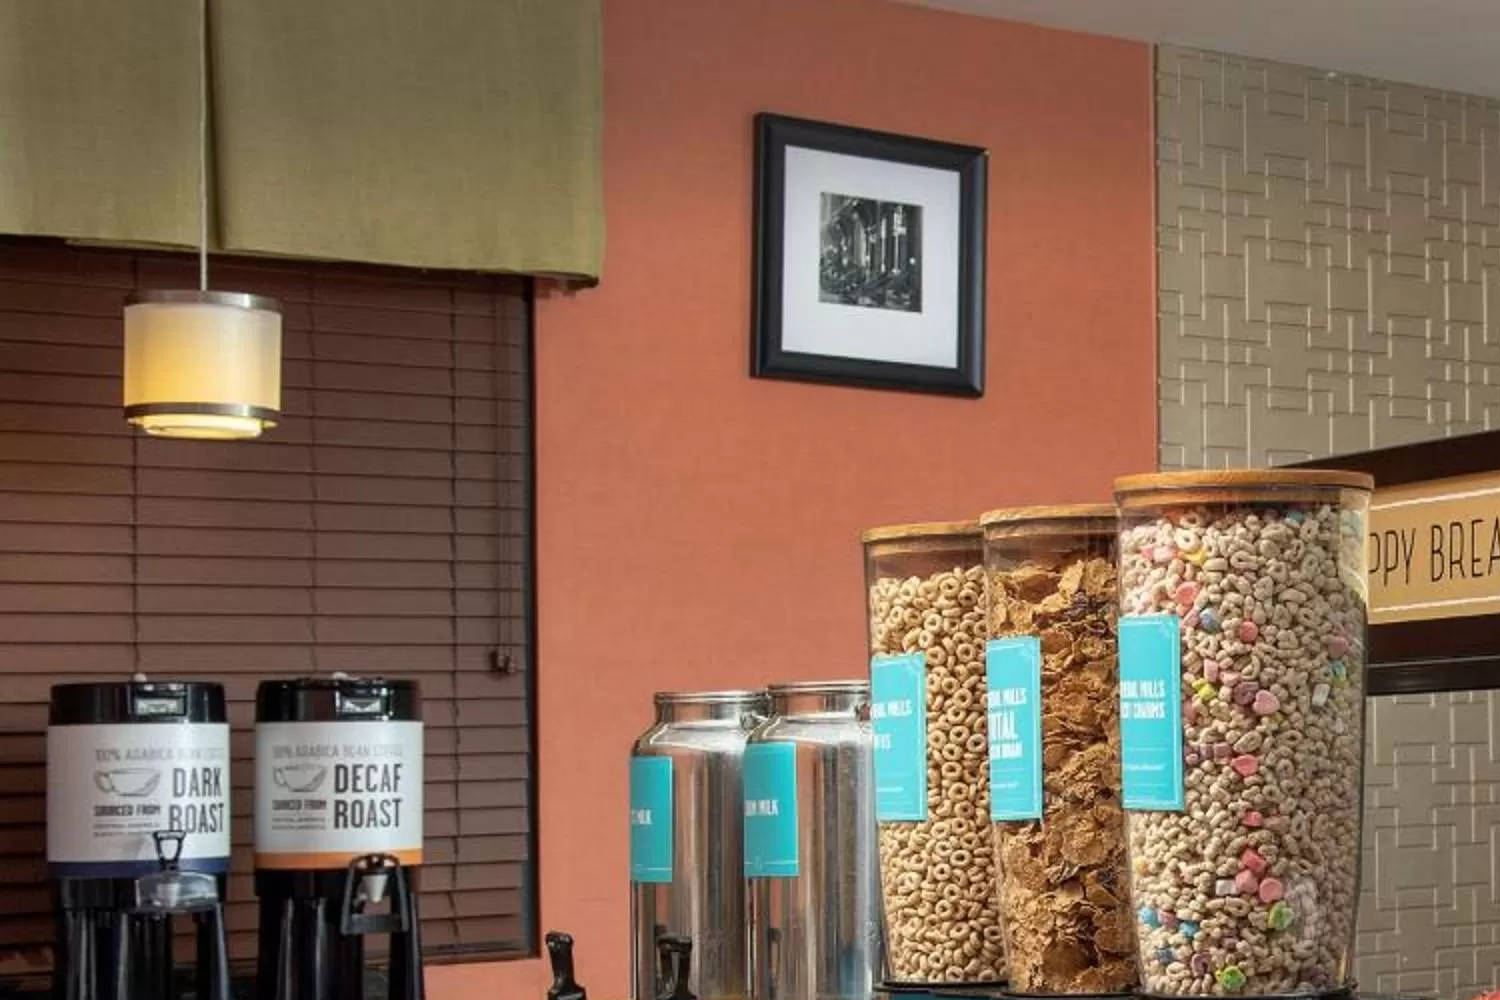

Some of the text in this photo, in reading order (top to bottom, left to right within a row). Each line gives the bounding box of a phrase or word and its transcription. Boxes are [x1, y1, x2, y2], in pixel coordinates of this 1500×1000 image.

[1368, 529, 1416, 587] PPY
[172, 767, 223, 797] DARK
[334, 763, 403, 793] DECAF
[168, 804, 224, 833] ROAST
[334, 798, 403, 829] ROAST
